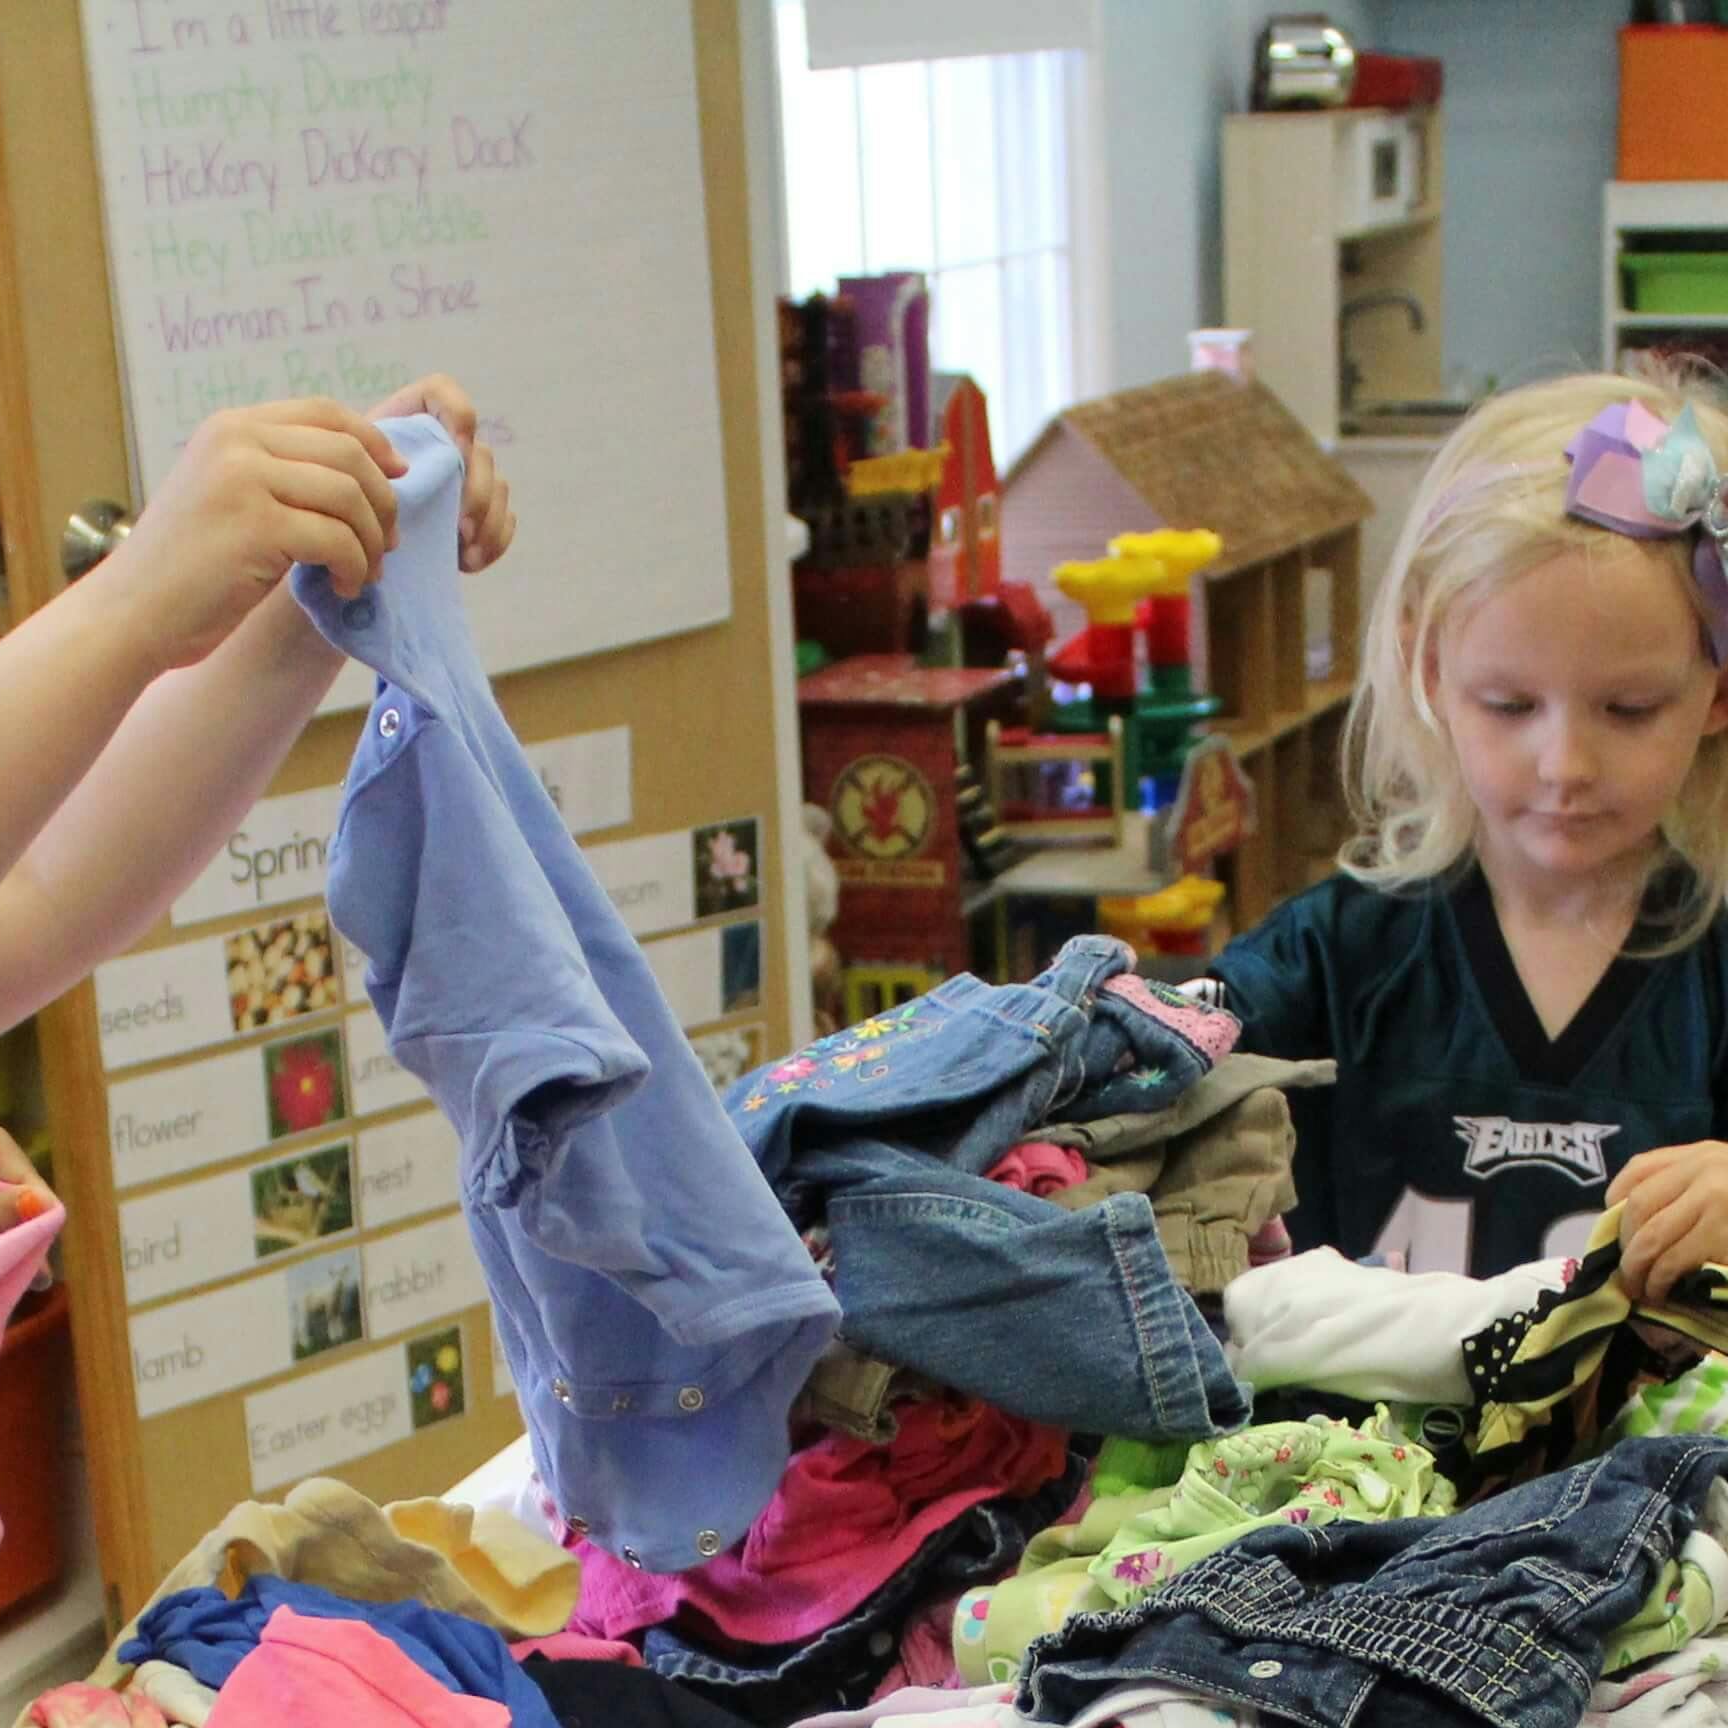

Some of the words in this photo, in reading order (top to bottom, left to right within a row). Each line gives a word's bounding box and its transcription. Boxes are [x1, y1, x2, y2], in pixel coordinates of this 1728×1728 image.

[228, 14, 254, 46] a
[147, 221, 232, 297] Hey
[156, 295, 289, 353] Woman
[390, 263, 480, 321] Shoe
[227, 830, 330, 901] Sprin
[100, 983, 186, 1036] seeds
[114, 1106, 203, 1153] flower
[1455, 1114, 1620, 1187] EAGLES
[124, 1230, 182, 1273] bird
[368, 1262, 448, 1304] rabbit
[134, 1340, 204, 1384] lamb
[249, 1413, 332, 1463] Easter
[338, 1390, 399, 1436] eggs
